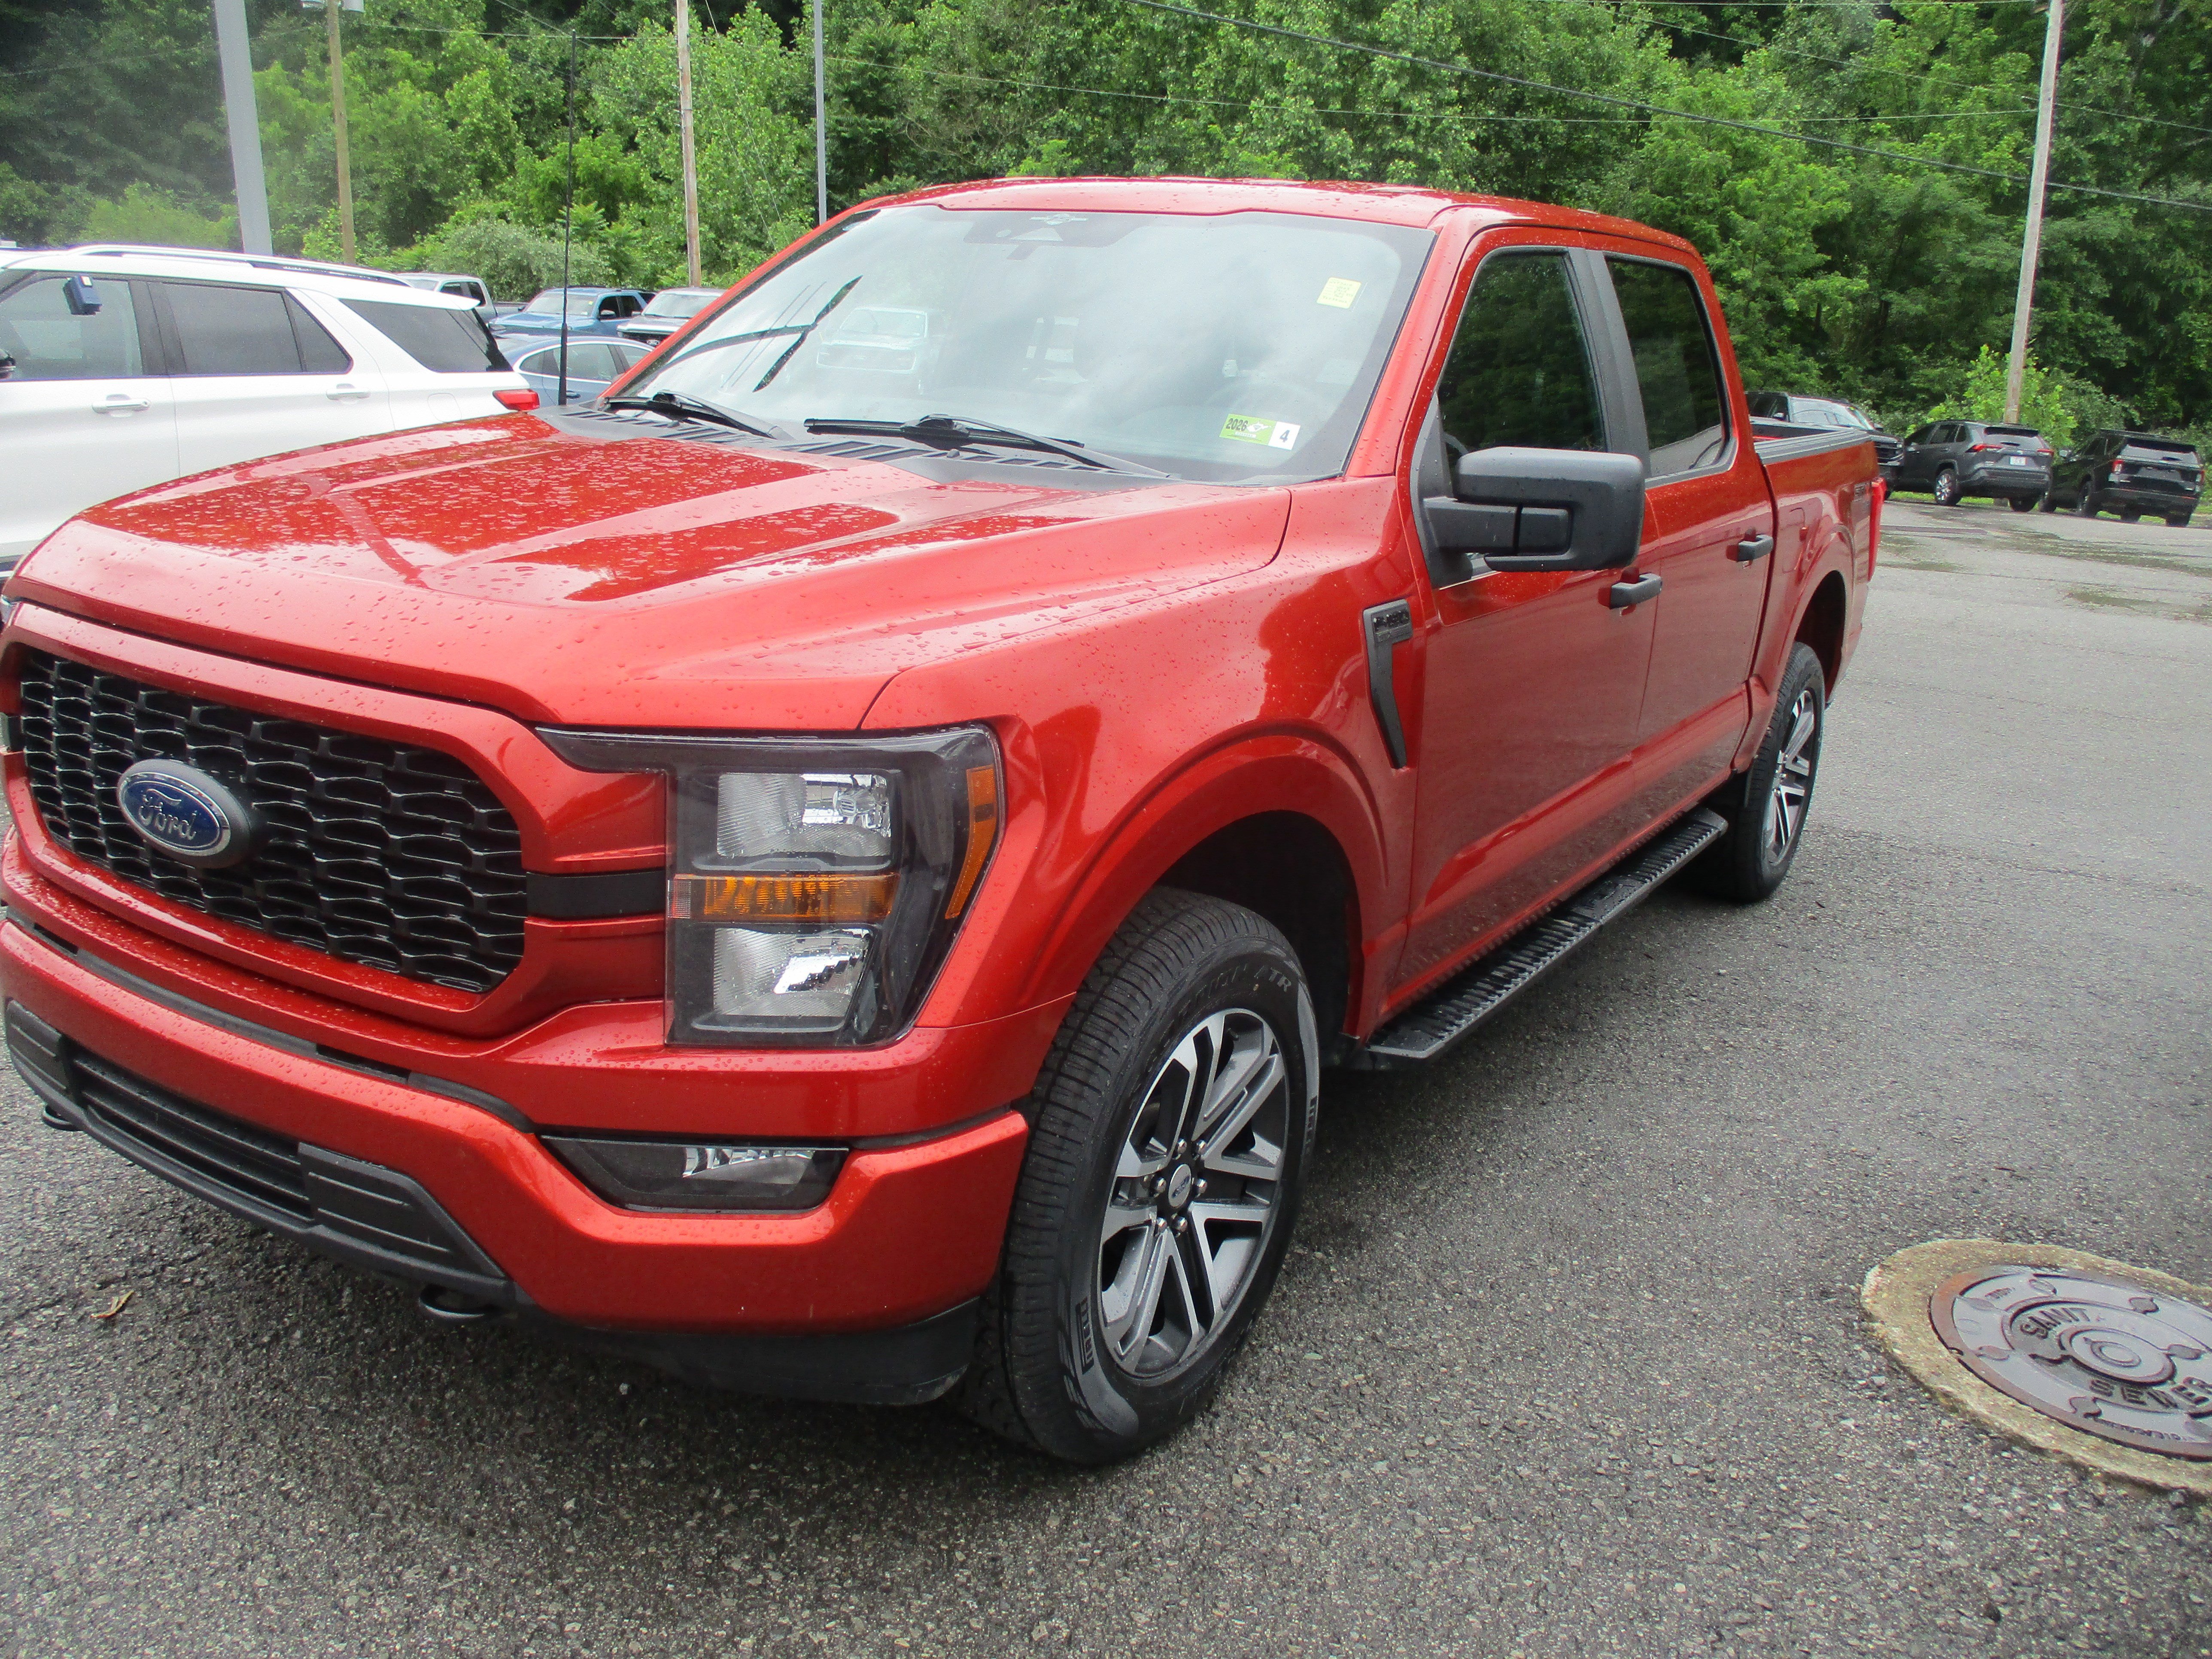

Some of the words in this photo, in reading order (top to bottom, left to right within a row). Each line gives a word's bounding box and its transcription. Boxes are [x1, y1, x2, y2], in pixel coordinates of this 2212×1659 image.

[1225, 418, 1248, 431] 2026
[1279, 430, 1290, 443] 4
[138, 788, 198, 840] Ford
[1076, 1297, 1094, 1374] PIRELLI
[2089, 1376, 2212, 1409] SEWER
